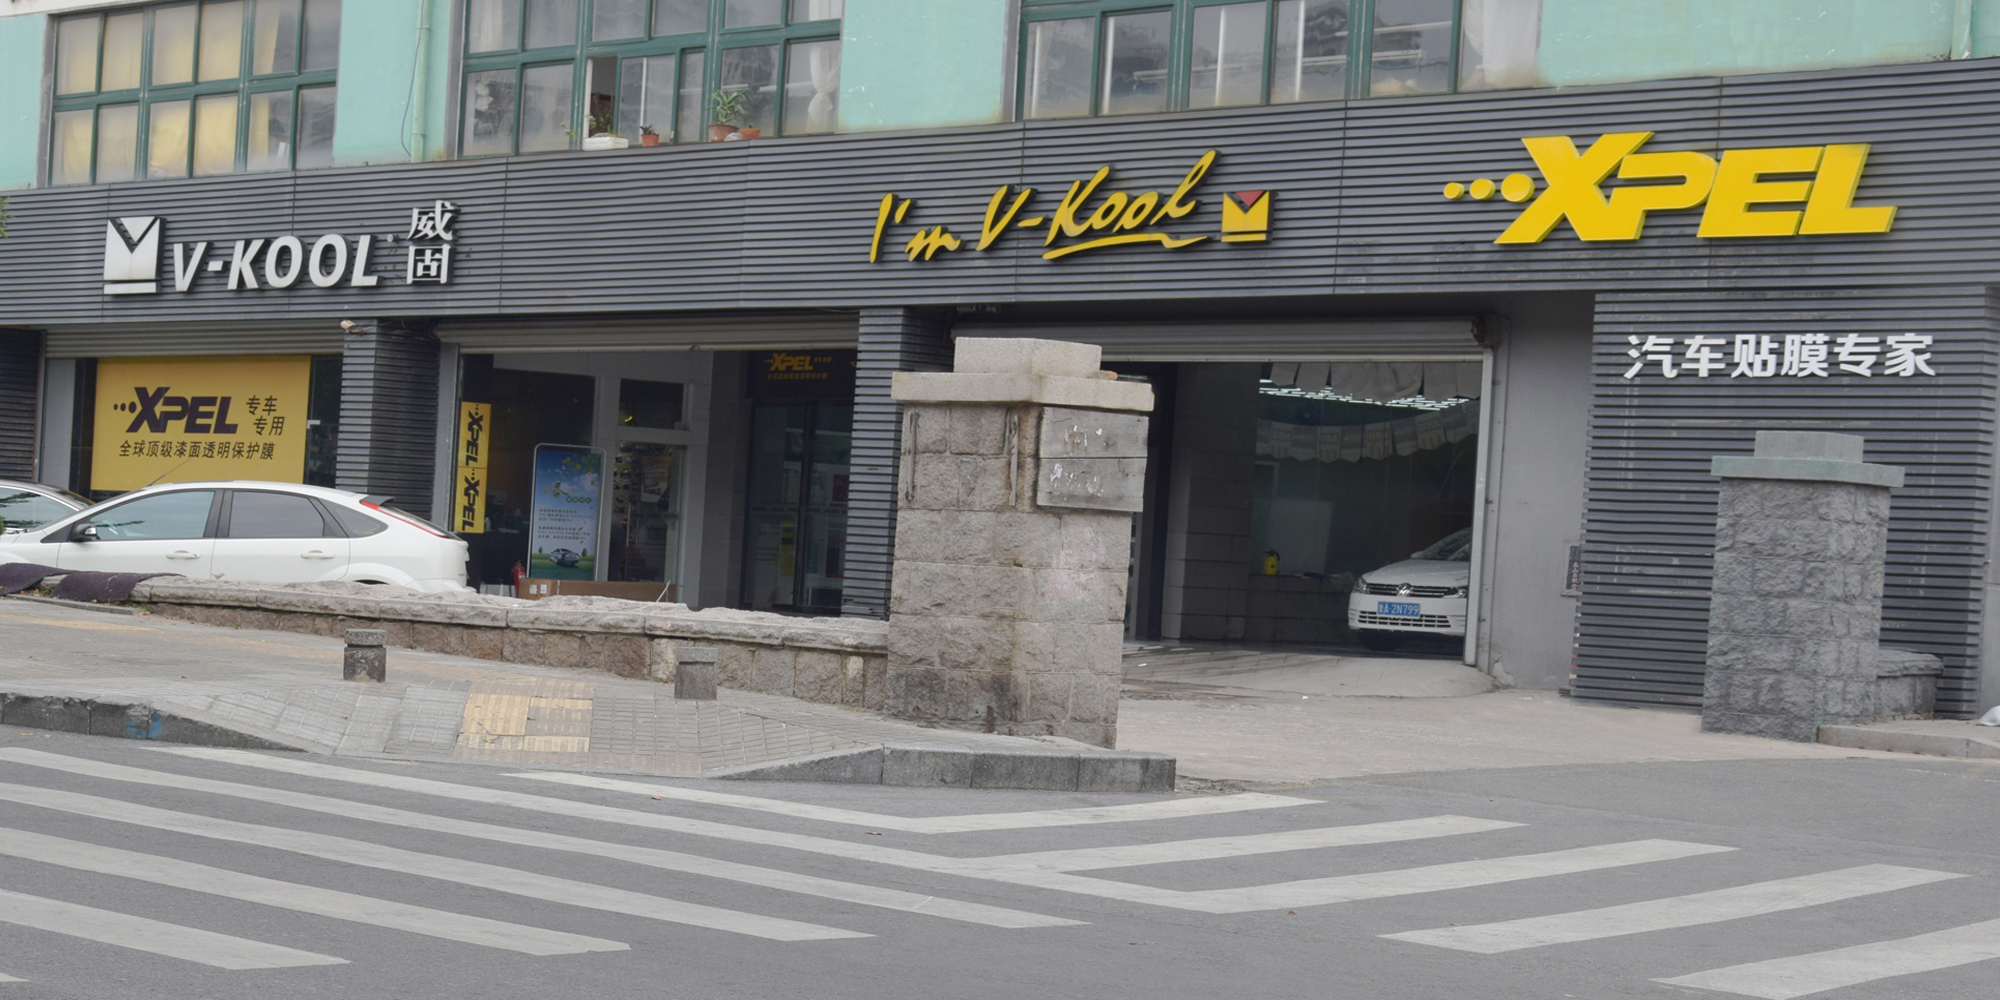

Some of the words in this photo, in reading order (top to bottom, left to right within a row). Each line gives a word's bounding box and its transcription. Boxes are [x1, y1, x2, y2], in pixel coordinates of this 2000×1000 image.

[870, 192, 962, 264] I'm
[975, 149, 1218, 252] V-Kool
[1494, 131, 1898, 244] XPEL
[173, 233, 379, 293] V-KOOL
[406, 199, 455, 285] 威固
[770, 353, 814, 371] XPEL
[1622, 333, 1937, 379] 汽车贴膜专家
[125, 386, 239, 434] XPEL
[246, 395, 278, 416] 专车
[253, 415, 285, 436] 专用
[119, 440, 275, 460] 全球顶级漆面透明保护膜
[465, 410, 484, 467] XPEL
[461, 475, 480, 532] XPEL
